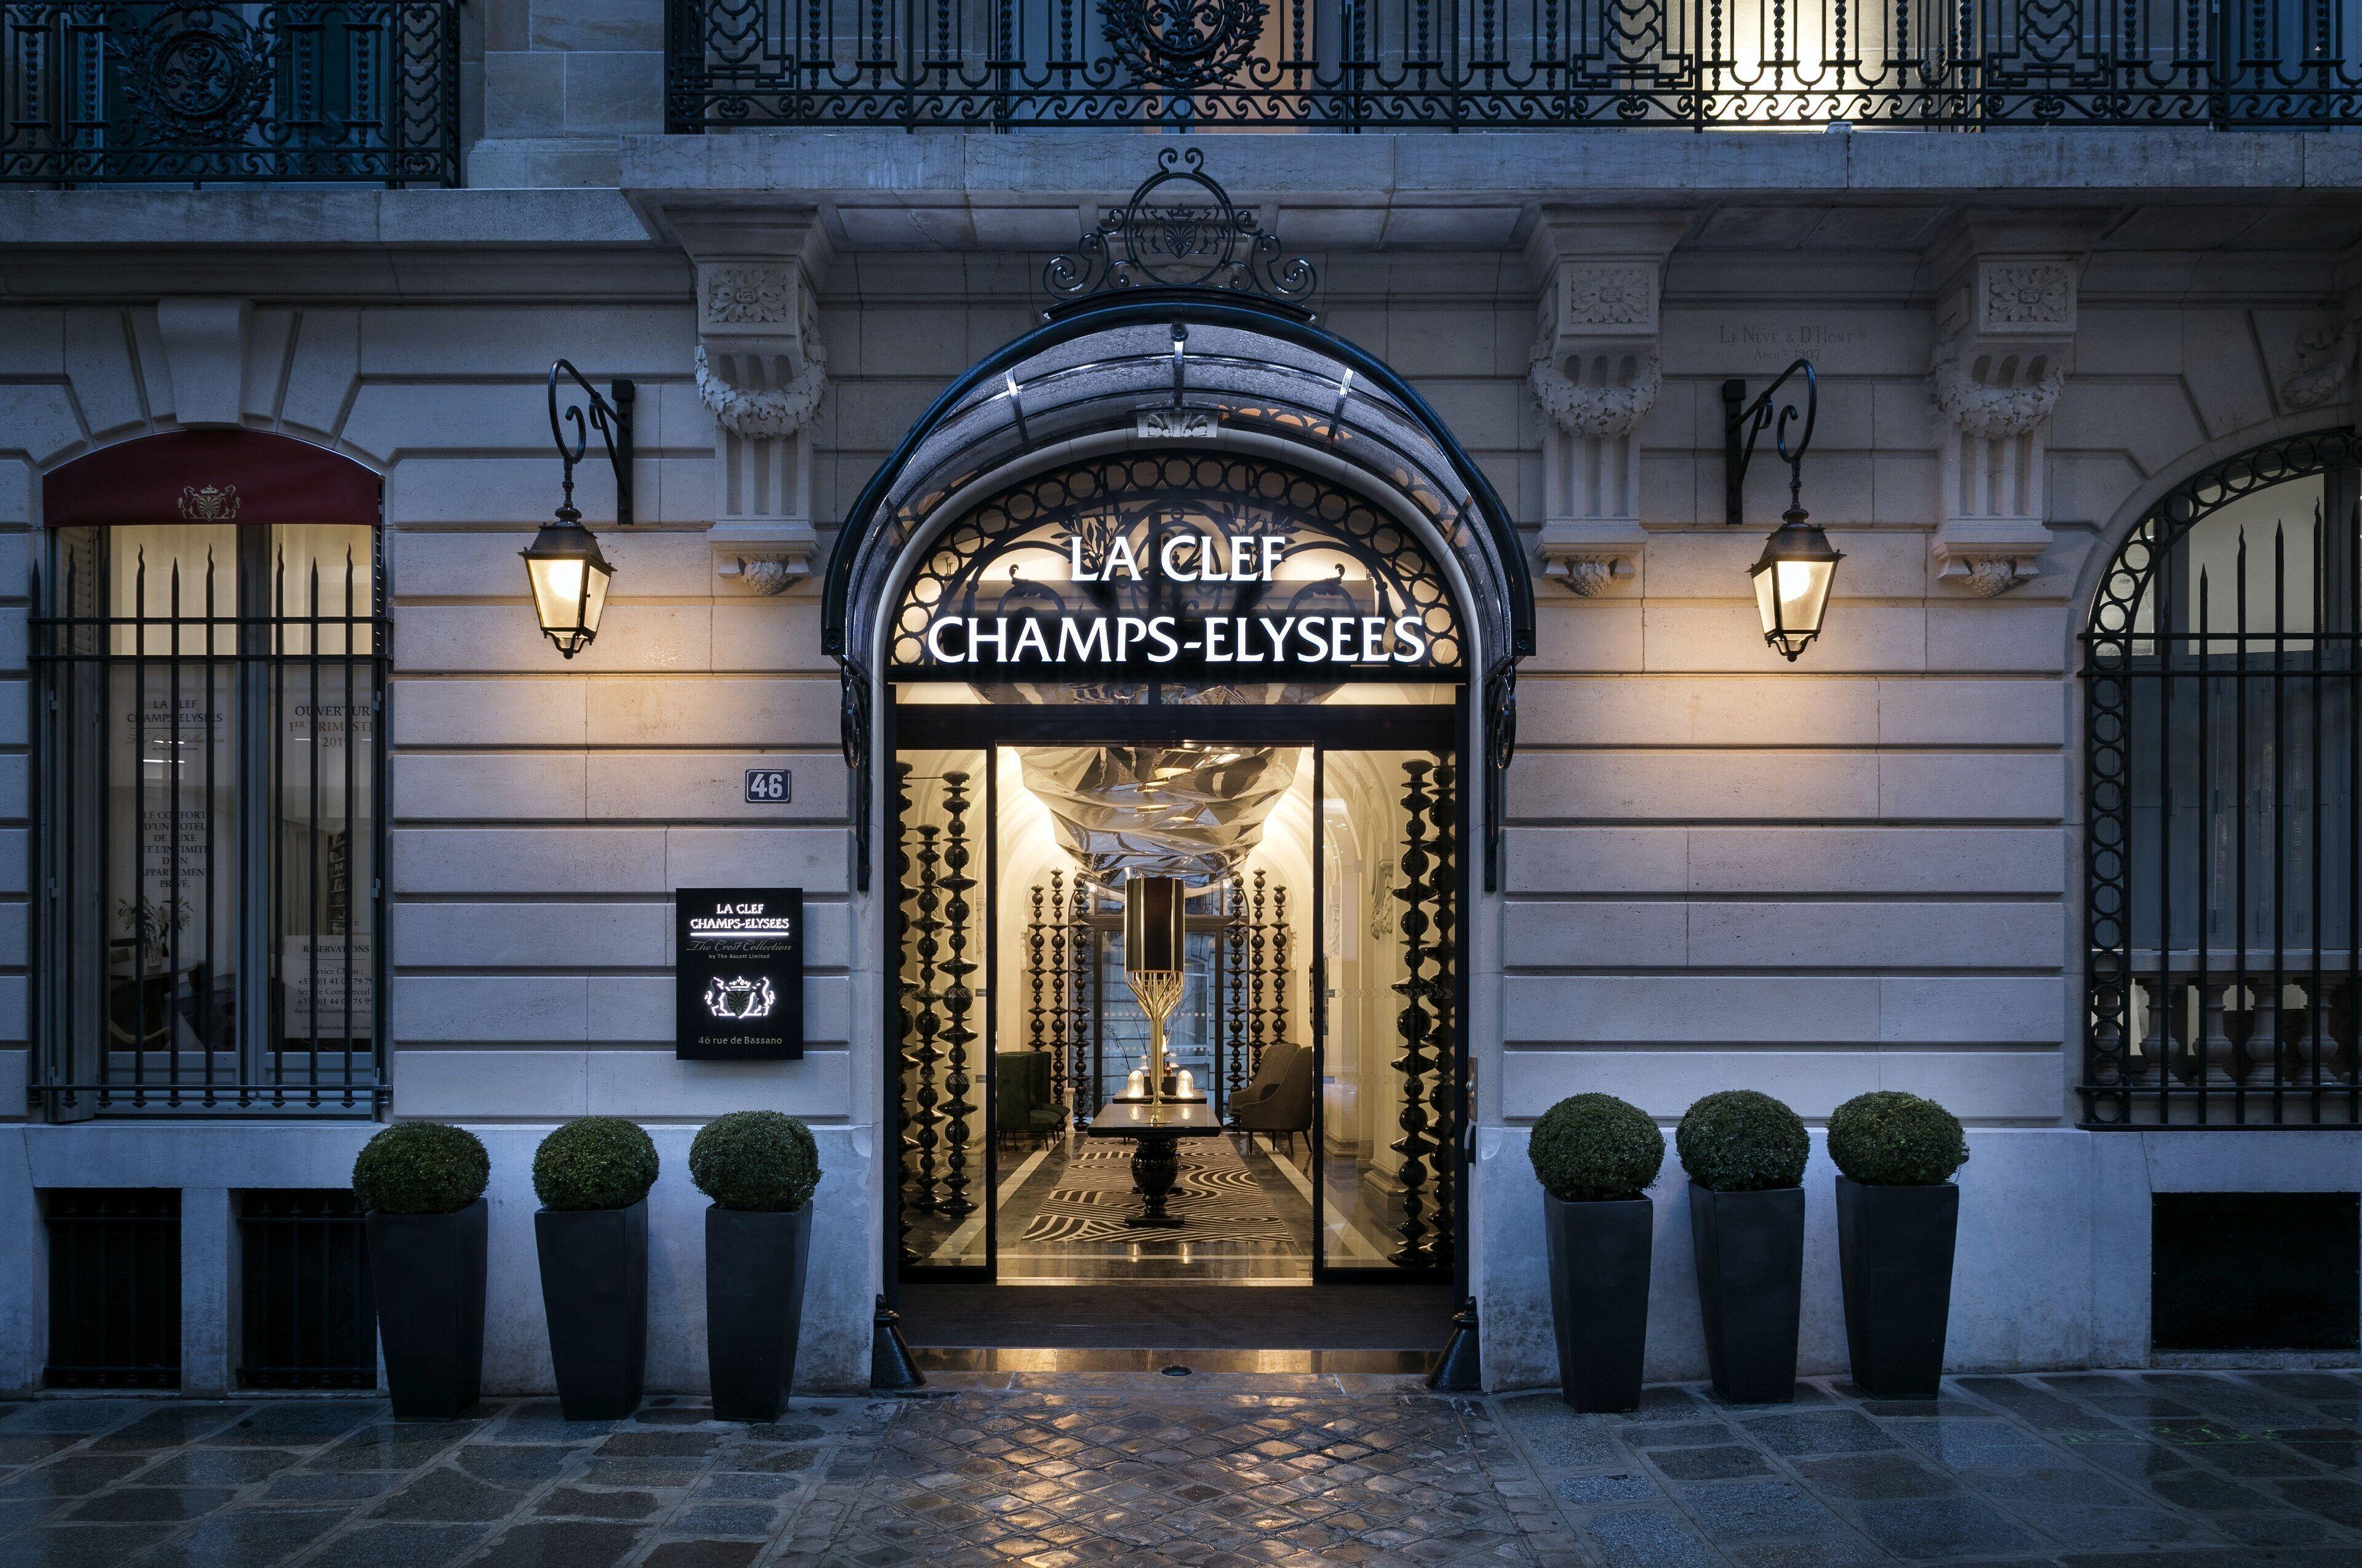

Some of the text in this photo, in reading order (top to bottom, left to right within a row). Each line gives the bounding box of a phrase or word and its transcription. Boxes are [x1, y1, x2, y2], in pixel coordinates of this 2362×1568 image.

[1786, 333, 1796, 346] &
[1795, 347, 1821, 361] 1907
[1070, 535, 1286, 583] LA CLEF
[927, 615, 1426, 664] CHAMPS-ELYSEES
[154, 700, 197, 709] LA LEF
[322, 737, 348, 747] 201
[750, 773, 782, 798] 46
[716, 904, 764, 914] LA CLEF
[690, 918, 789, 929] CHAMPS-ELYSEES
[686, 937, 792, 951] The Crest Collection
[730, 1036, 742, 1045] de
